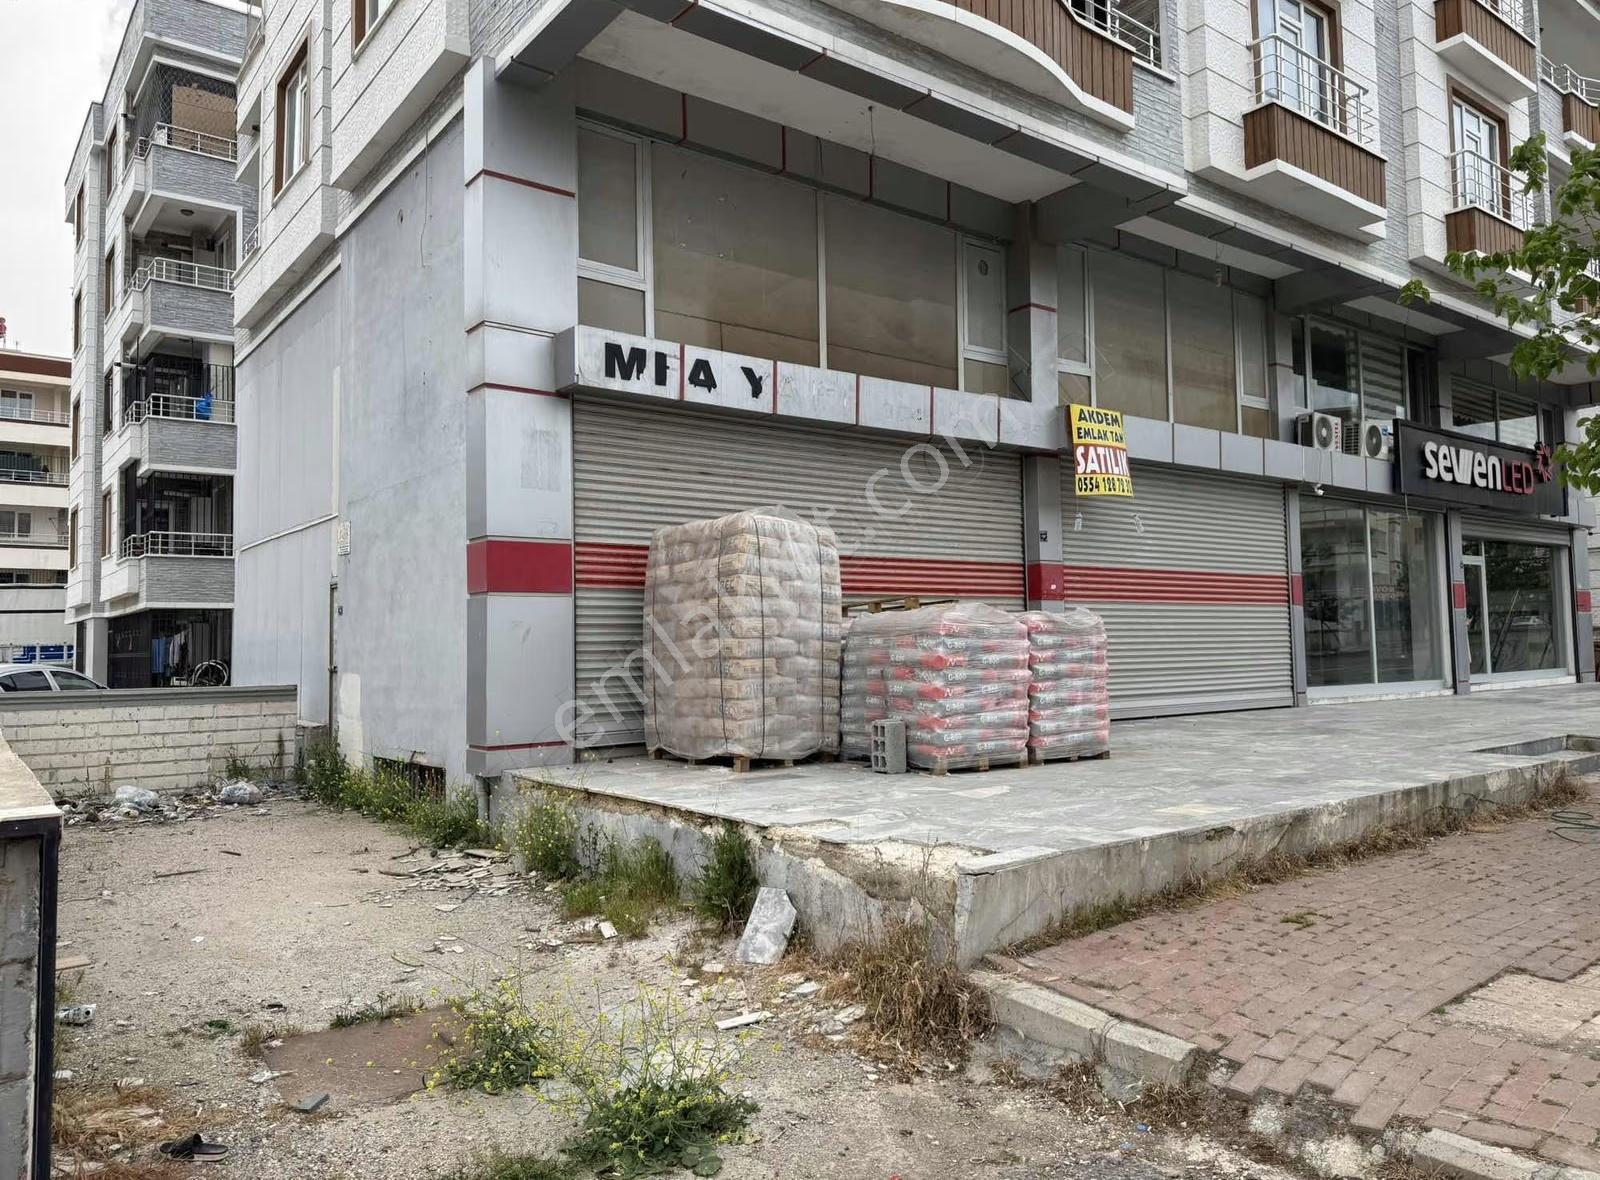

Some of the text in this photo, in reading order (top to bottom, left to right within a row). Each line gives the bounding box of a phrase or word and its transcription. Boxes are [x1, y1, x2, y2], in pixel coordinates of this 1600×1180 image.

[1078, 408, 1121, 428] AKDEM
[1077, 427, 1109, 442] EMLAK
[1078, 477, 1100, 493] 0554
